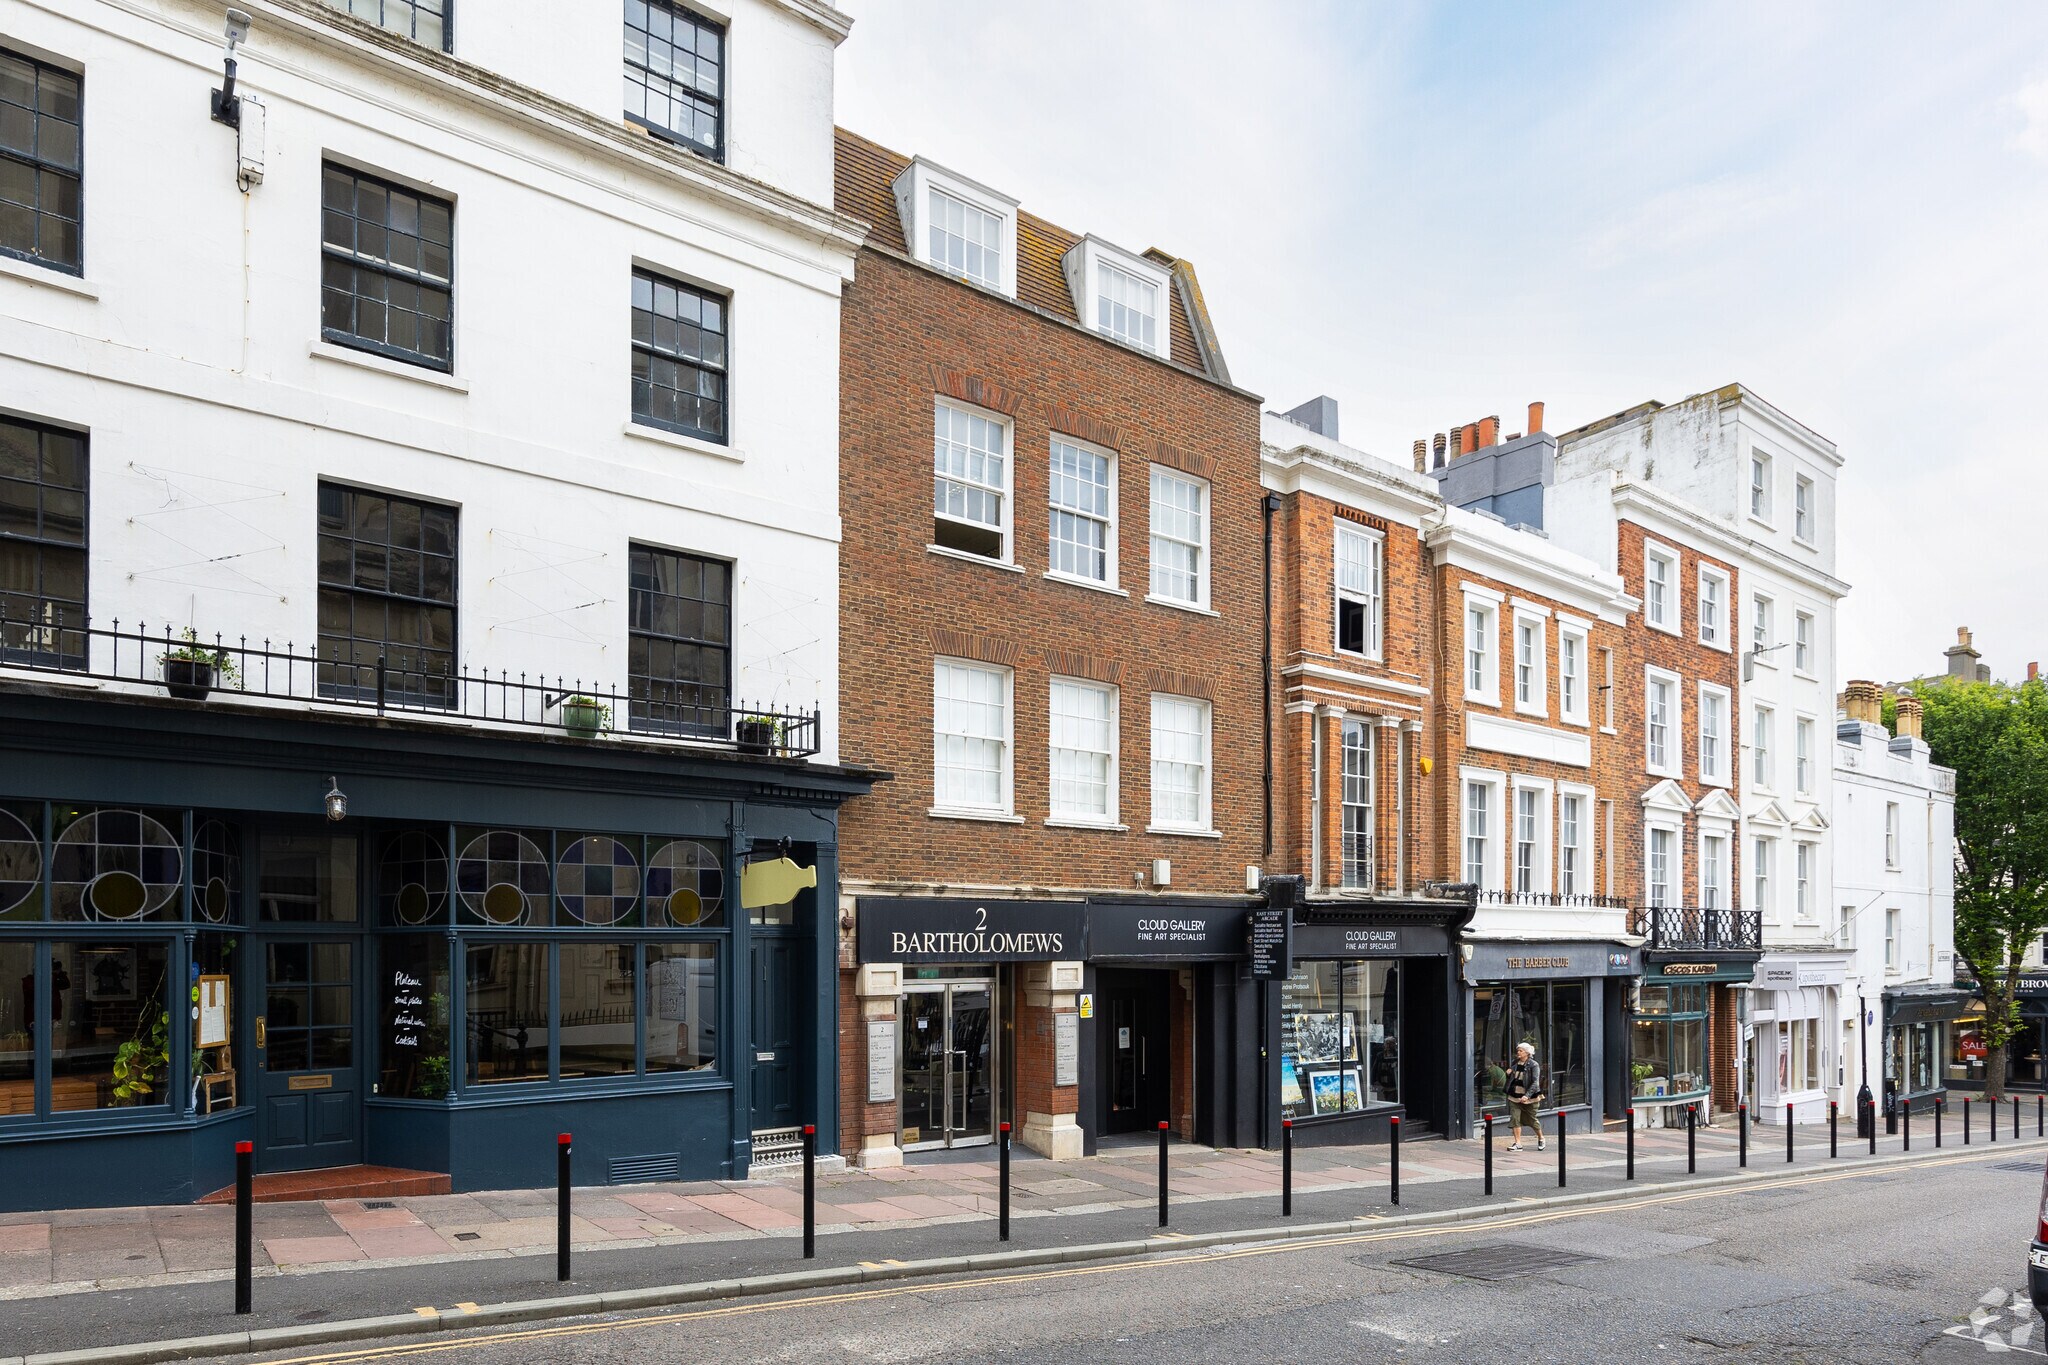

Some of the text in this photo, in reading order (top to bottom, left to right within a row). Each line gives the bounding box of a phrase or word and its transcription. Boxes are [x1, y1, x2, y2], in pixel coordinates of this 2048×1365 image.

[975, 907, 987, 930] 2
[1138, 919, 1206, 930] CLOUD GALLERY
[1345, 931, 1396, 941] CLOUD GALLERY
[892, 932, 1063, 953] BARTHOLOMEWS
[1507, 957, 1569, 968] THE BARBER CLUB
[395, 971, 422, 986] Plateau
[1962, 1041, 1987, 1050] SALE
